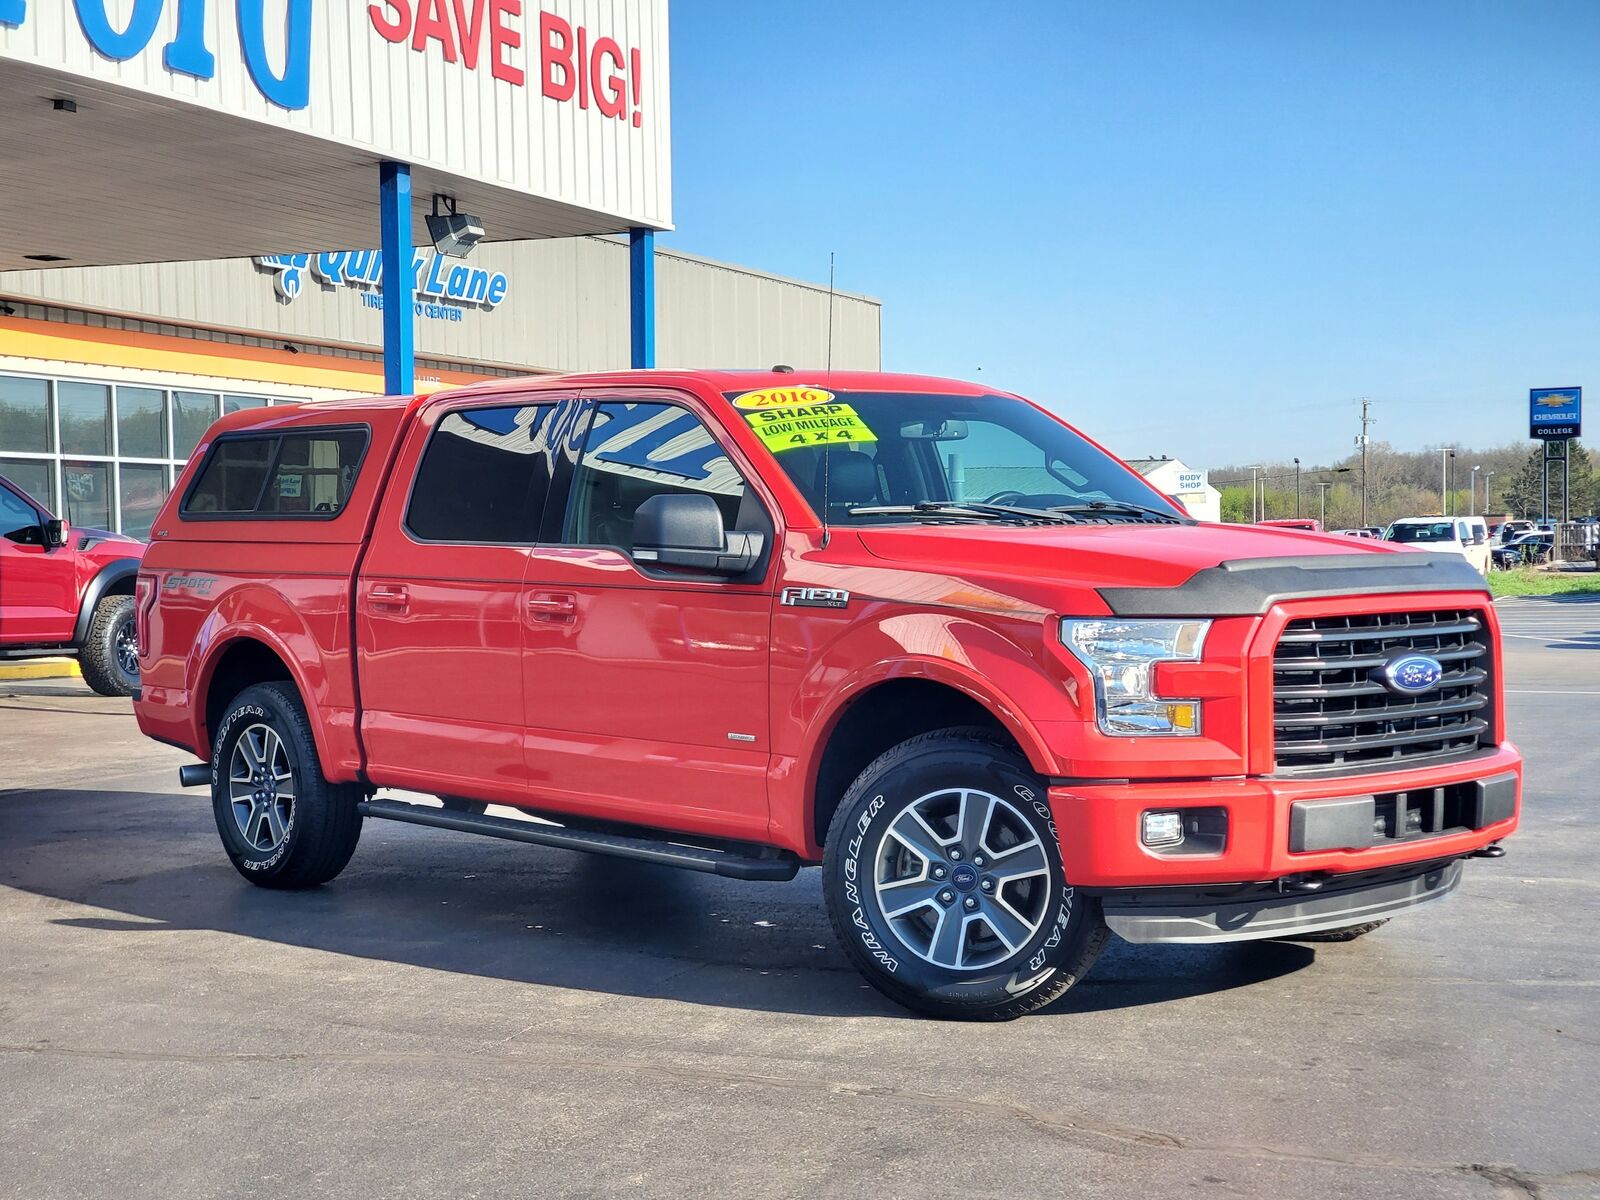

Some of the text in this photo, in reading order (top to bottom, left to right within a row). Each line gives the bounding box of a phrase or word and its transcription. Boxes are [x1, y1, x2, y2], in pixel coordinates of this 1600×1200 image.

[540, 9, 642, 129] BIG!
[426, 252, 508, 305] Lane
[361, 292, 384, 310] TIRE
[425, 304, 463, 322] CENTER
[751, 390, 817, 407] 2016
[759, 405, 842, 422] SHARP
[762, 417, 856, 437] LOW MILEAGE
[163, 575, 217, 589] SPORT
[1403, 664, 1433, 684] Ford
[844, 794, 899, 973] WRANGLER
[1014, 784, 1074, 972] GOOYEAR
